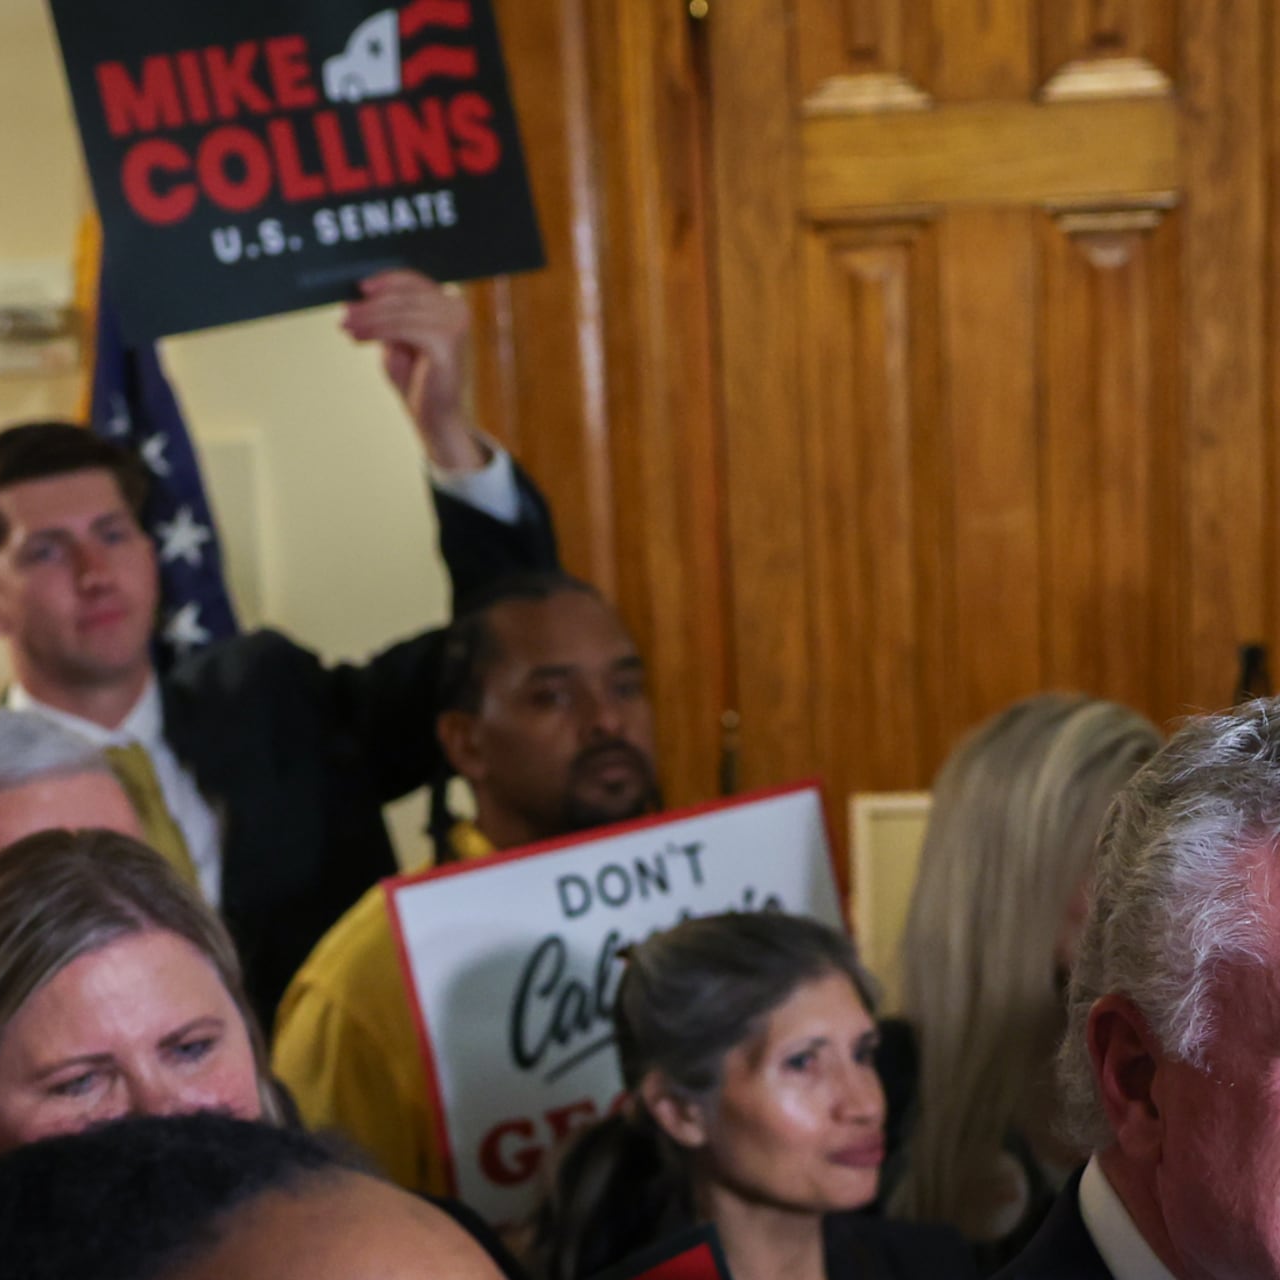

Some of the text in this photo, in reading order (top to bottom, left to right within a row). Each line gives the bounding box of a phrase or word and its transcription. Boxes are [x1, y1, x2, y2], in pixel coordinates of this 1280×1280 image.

[95, 35, 318, 138] MIKE
[123, 92, 503, 226] COLLINS
[210, 190, 458, 264] U.S. SENATE
[557, 840, 705, 919] DON'T
